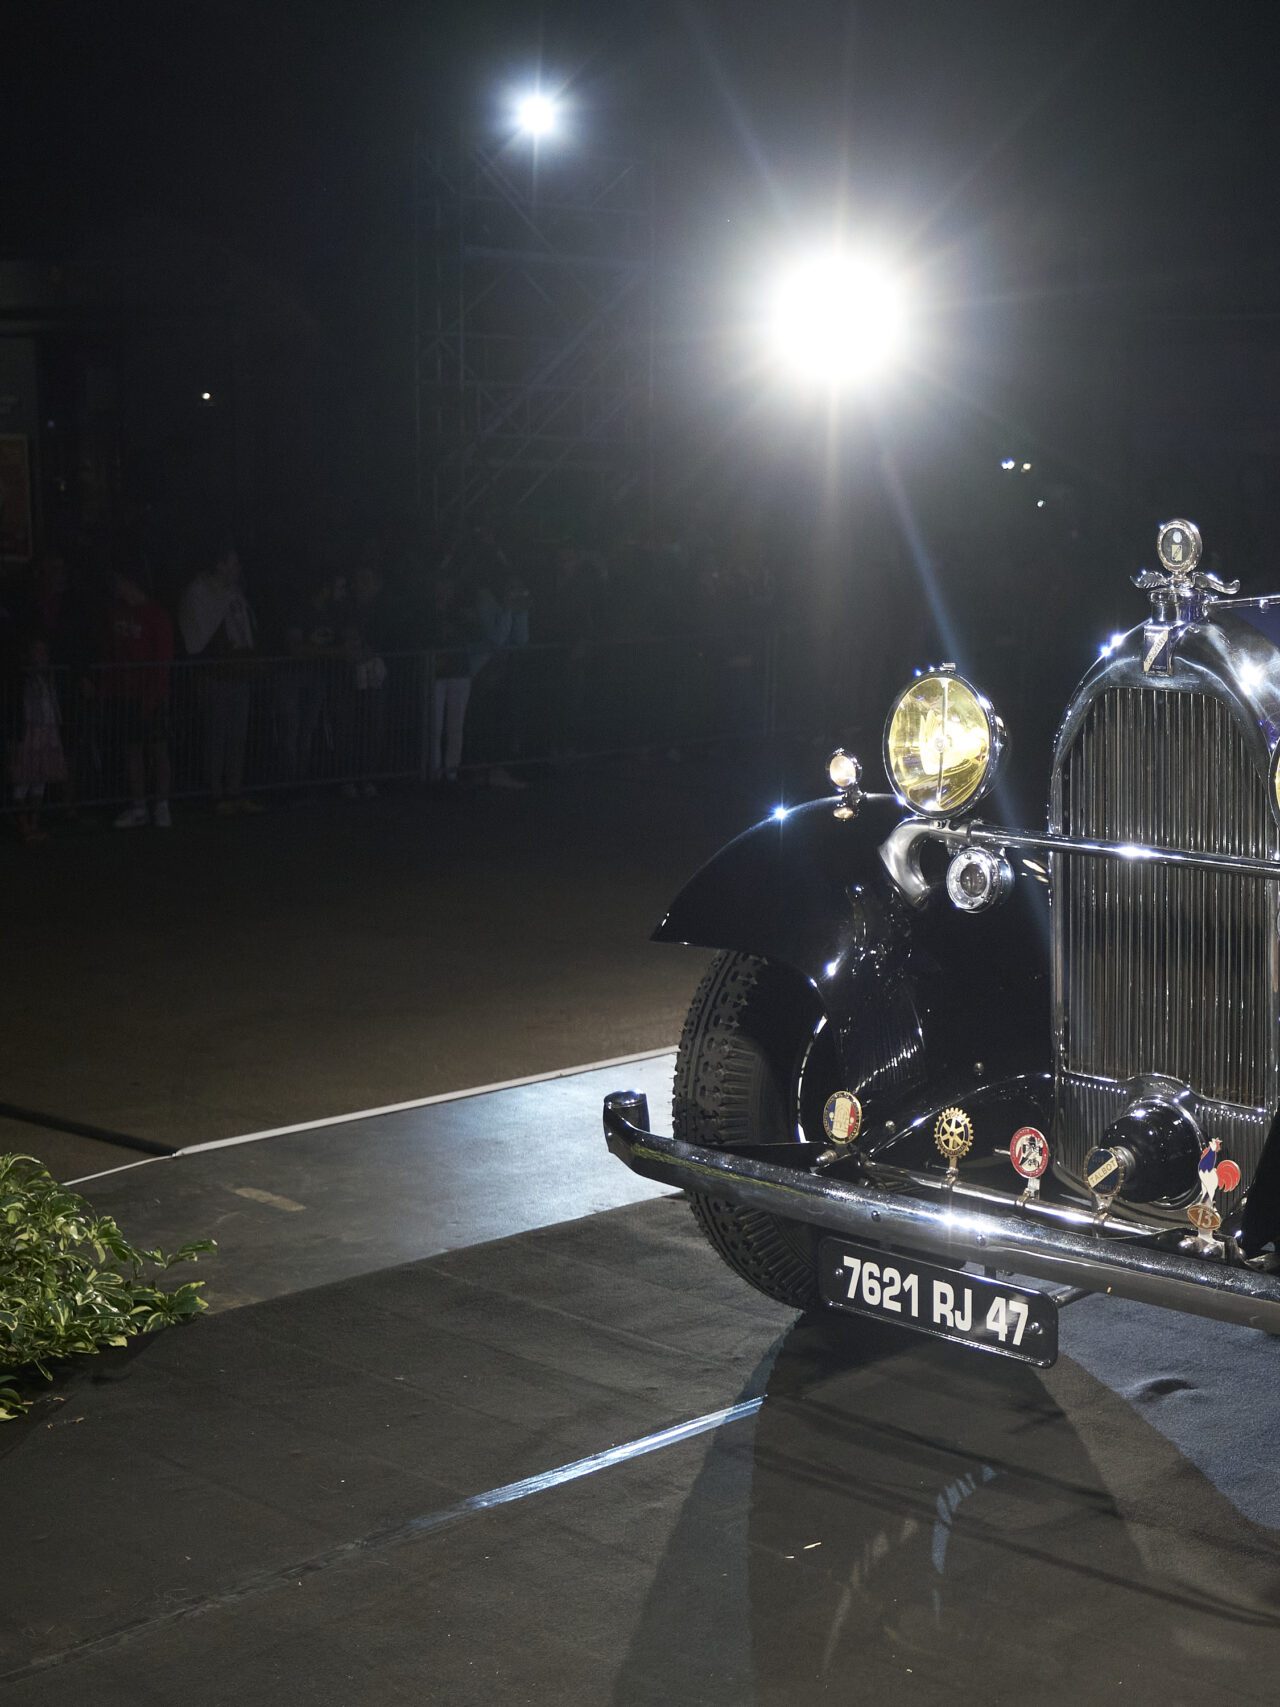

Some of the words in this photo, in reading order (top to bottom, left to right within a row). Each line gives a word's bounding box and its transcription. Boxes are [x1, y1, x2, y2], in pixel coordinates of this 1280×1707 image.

[1089, 1160, 1116, 1184] TALBOT
[1196, 1208, 1213, 1228] 13
[843, 1255, 919, 1318] 7621
[933, 1280, 973, 1332] RJ
[986, 1296, 1030, 1346] 47
